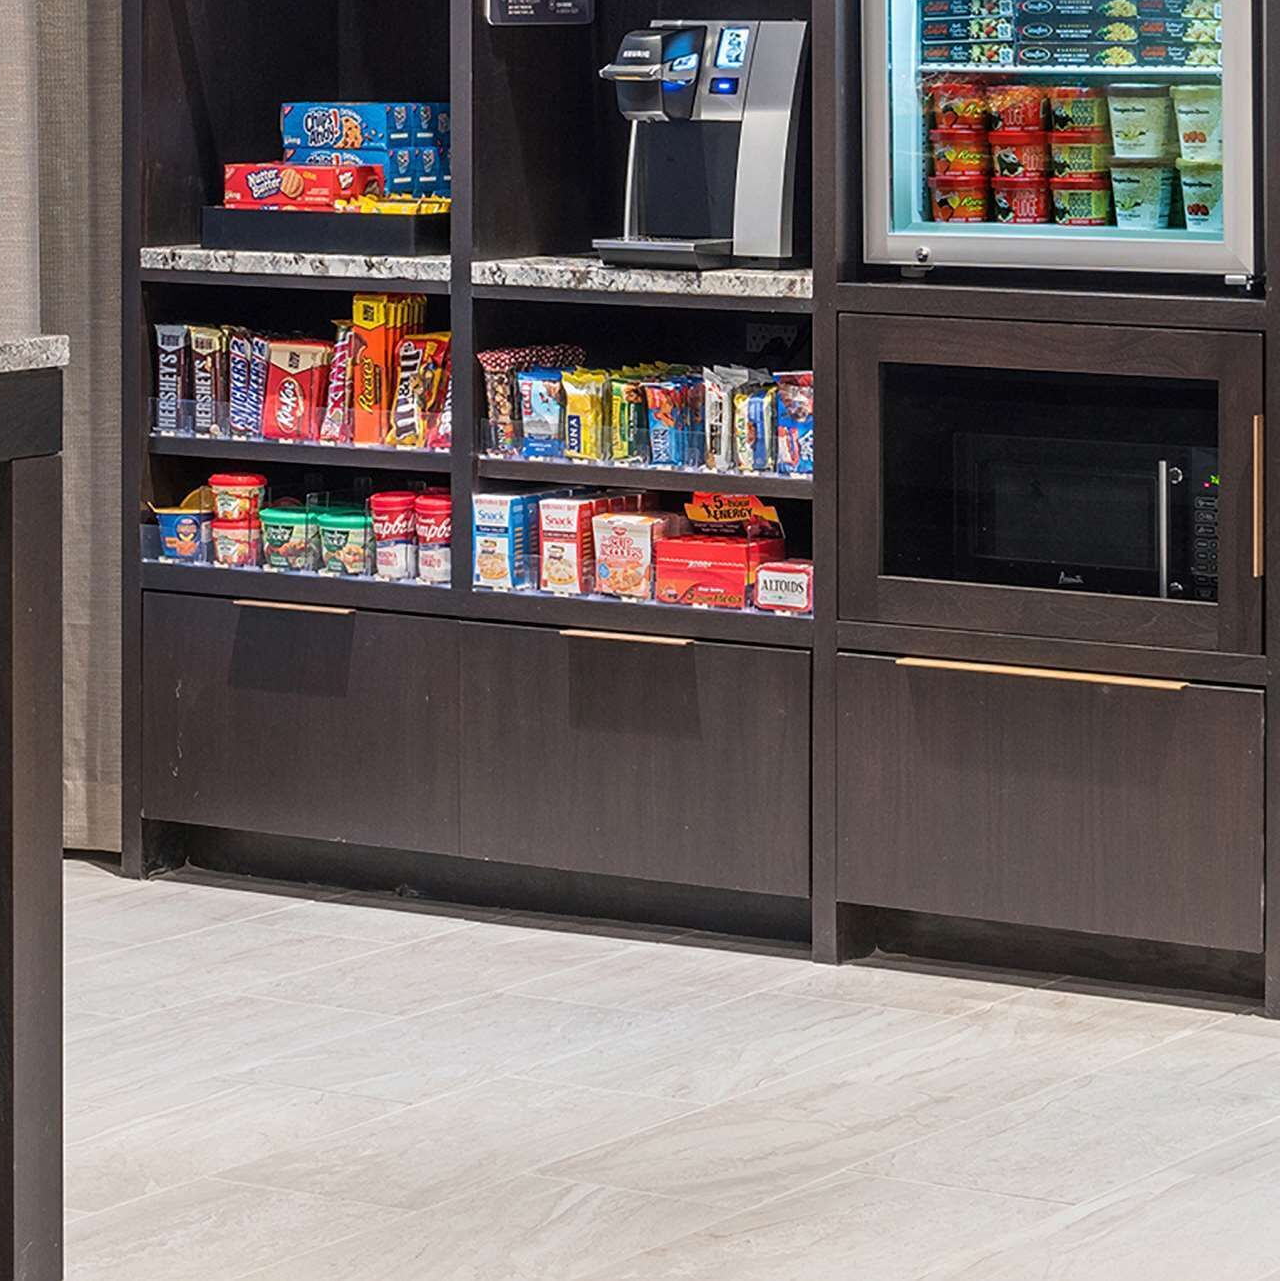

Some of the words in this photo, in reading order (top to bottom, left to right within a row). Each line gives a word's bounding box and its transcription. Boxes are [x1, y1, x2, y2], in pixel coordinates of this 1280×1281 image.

[158, 353, 177, 429] HERSHEY'S
[194, 359, 213, 428] HERSHEY'S
[231, 355, 248, 430] SNICKERS
[247, 358, 266, 432] SNICKERS
[762, 578, 805, 594] ALTOIDS
